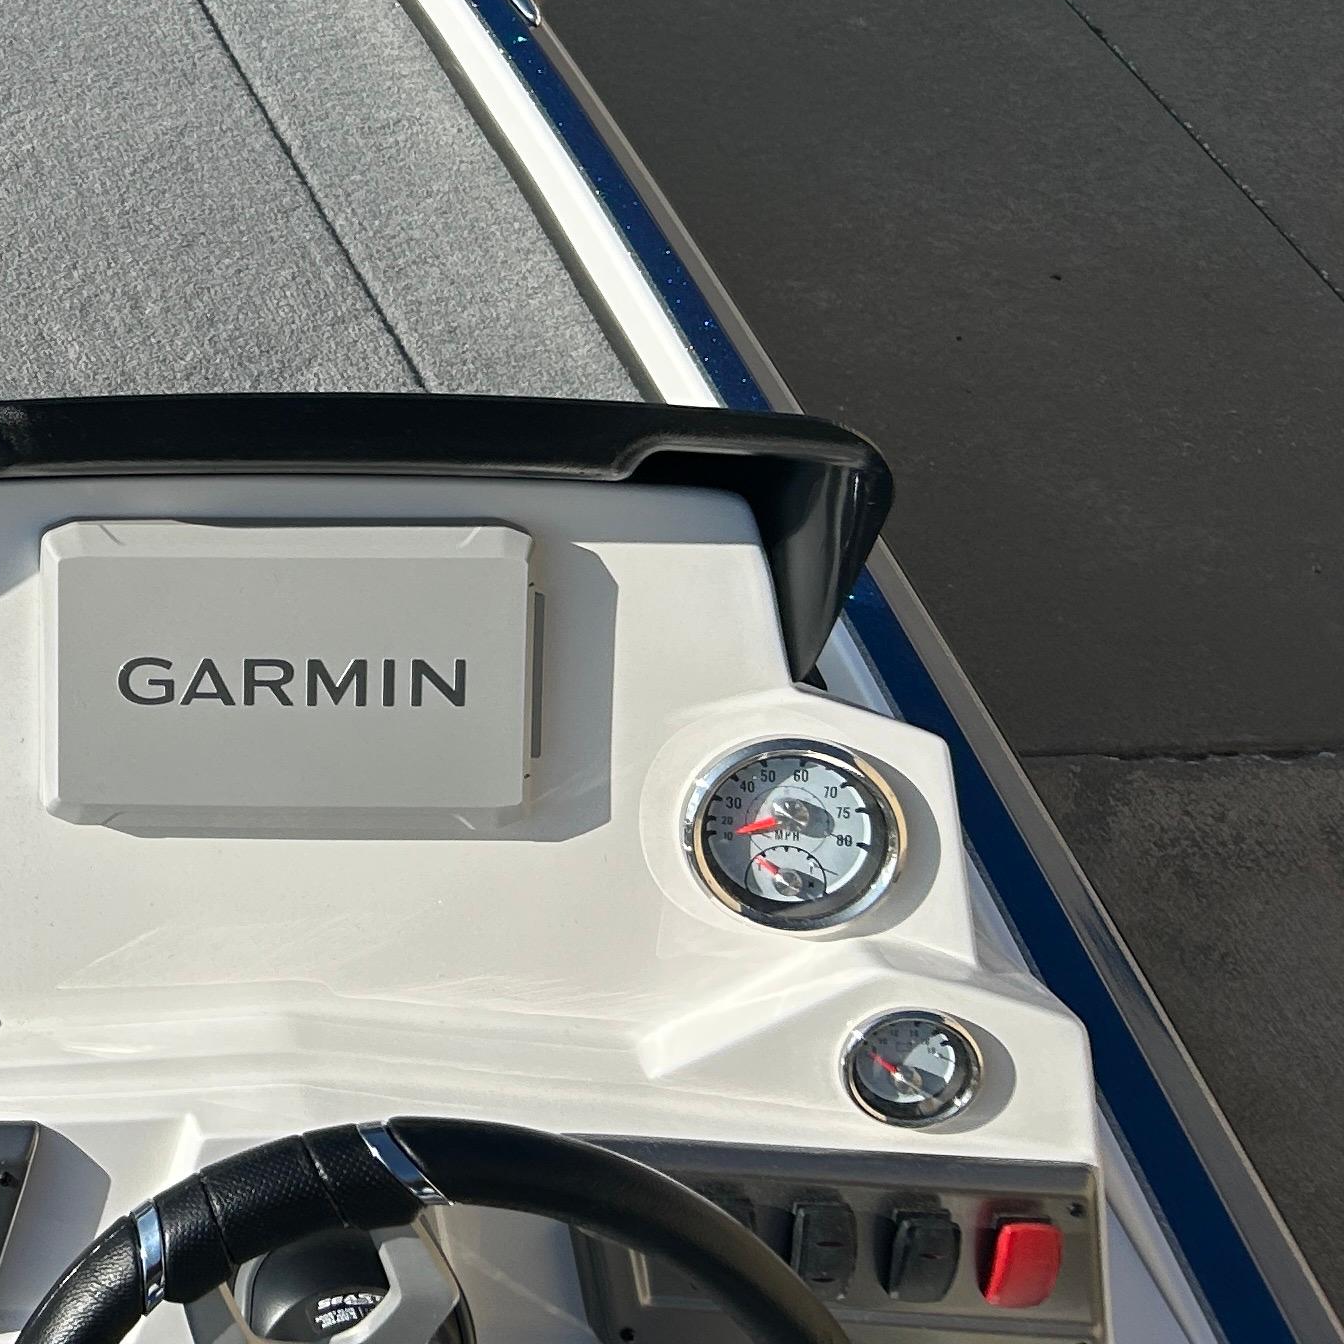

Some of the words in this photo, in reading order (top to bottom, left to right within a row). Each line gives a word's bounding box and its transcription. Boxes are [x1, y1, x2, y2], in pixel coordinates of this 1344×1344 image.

[117, 657, 466, 707] GARMIN
[760, 770, 776, 783] 50
[793, 770, 809, 782] 60
[740, 781, 755, 793] 40
[824, 786, 837, 798] 70
[726, 797, 741, 809] 30
[837, 807, 850, 819] 75
[721, 816, 733, 825] 20
[723, 832, 733, 841] 10
[774, 830, 800, 841] MPH
[836, 835, 852, 847] 80
